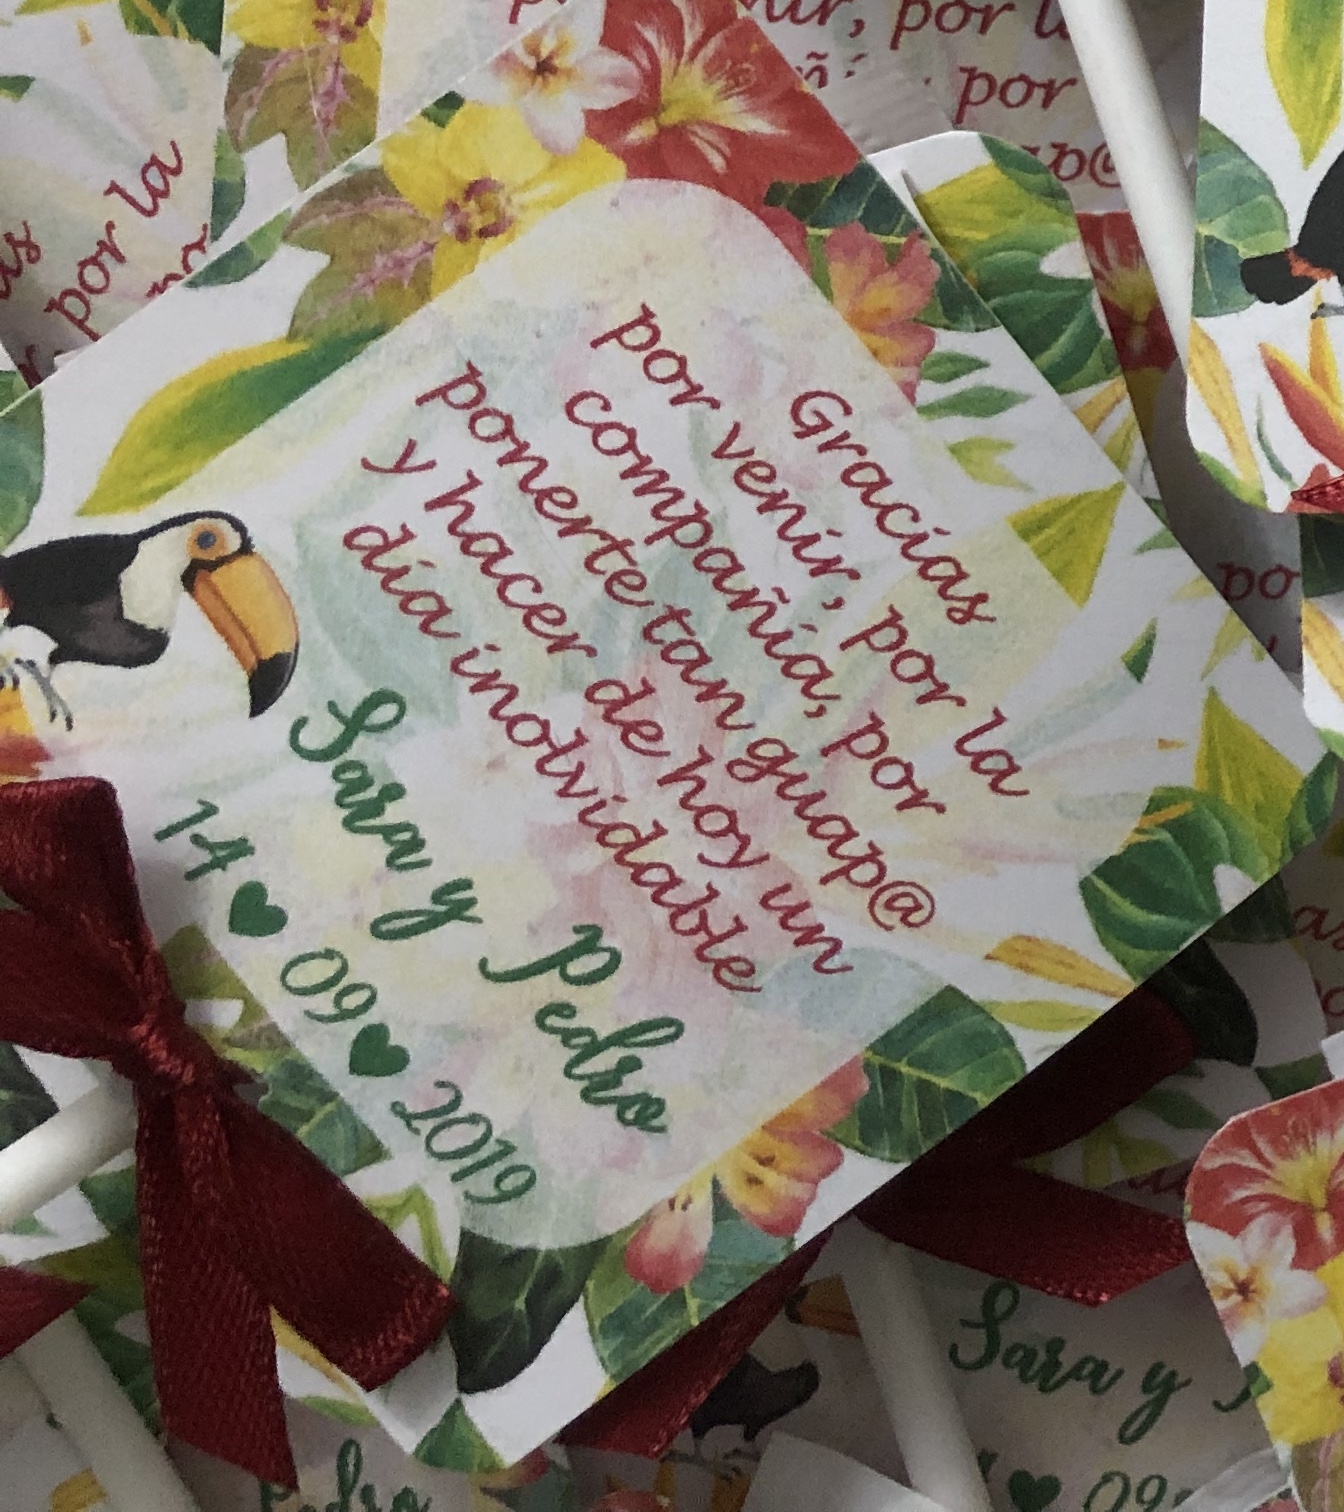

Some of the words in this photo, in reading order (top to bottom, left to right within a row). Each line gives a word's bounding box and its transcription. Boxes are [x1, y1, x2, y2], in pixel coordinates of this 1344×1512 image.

[43, 220, 127, 342] por
[103, 140, 183, 217] la
[953, 66, 1079, 126] por
[415, 361, 652, 608] ponerte
[642, 605, 754, 731] tan
[725, 738, 935, 931] guap@
[590, 302, 721, 410] por
[711, 421, 861, 610] venir,
[839, 604, 967, 707] por
[954, 706, 1030, 797] la
[790, 390, 996, 626] Gracias
[450, 644, 759, 992] inolvidable
[820, 710, 946, 814] por
[153, 799, 256, 882] 14
[279, 946, 378, 1024] 09
[390, 1079, 537, 1206] 2019
[289, 689, 432, 872] Sara
[369, 877, 483, 941] y
[478, 924, 686, 1134] Pedro
[949, 1281, 1122, 1396] Sara
